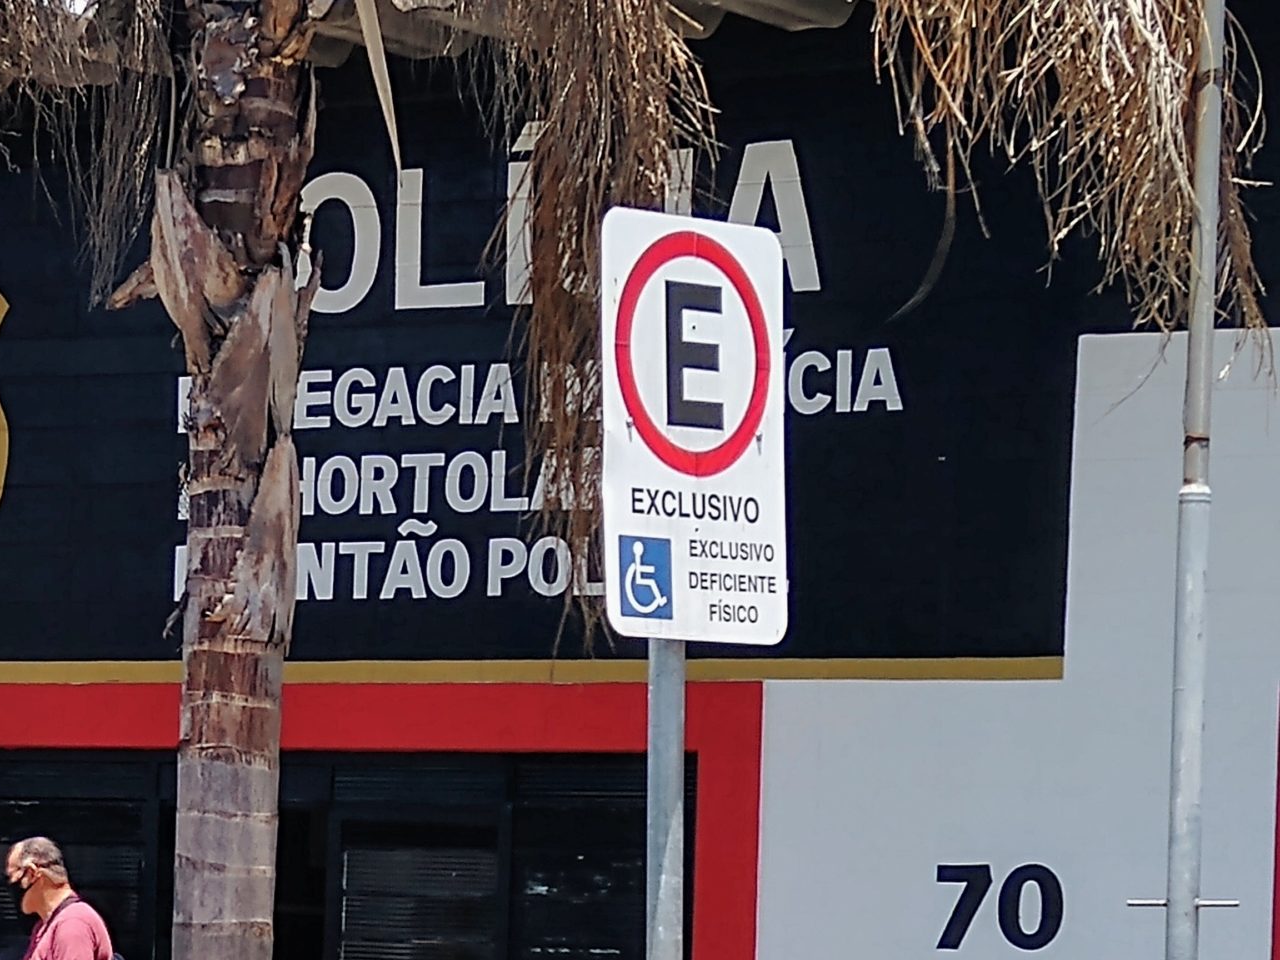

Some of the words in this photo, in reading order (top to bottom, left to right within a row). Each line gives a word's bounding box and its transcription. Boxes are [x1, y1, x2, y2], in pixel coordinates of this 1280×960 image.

[665, 279, 725, 431] E
[177, 363, 520, 434] EGACIA
[631, 487, 760, 524] EXCLUSIVO
[173, 518, 471, 602] NTÃO
[688, 539, 775, 562] EXCLUSIVO
[688, 571, 777, 594] DEFICIENTE
[708, 599, 759, 624] FÍSICO
[935, 863, 1065, 952] 70
